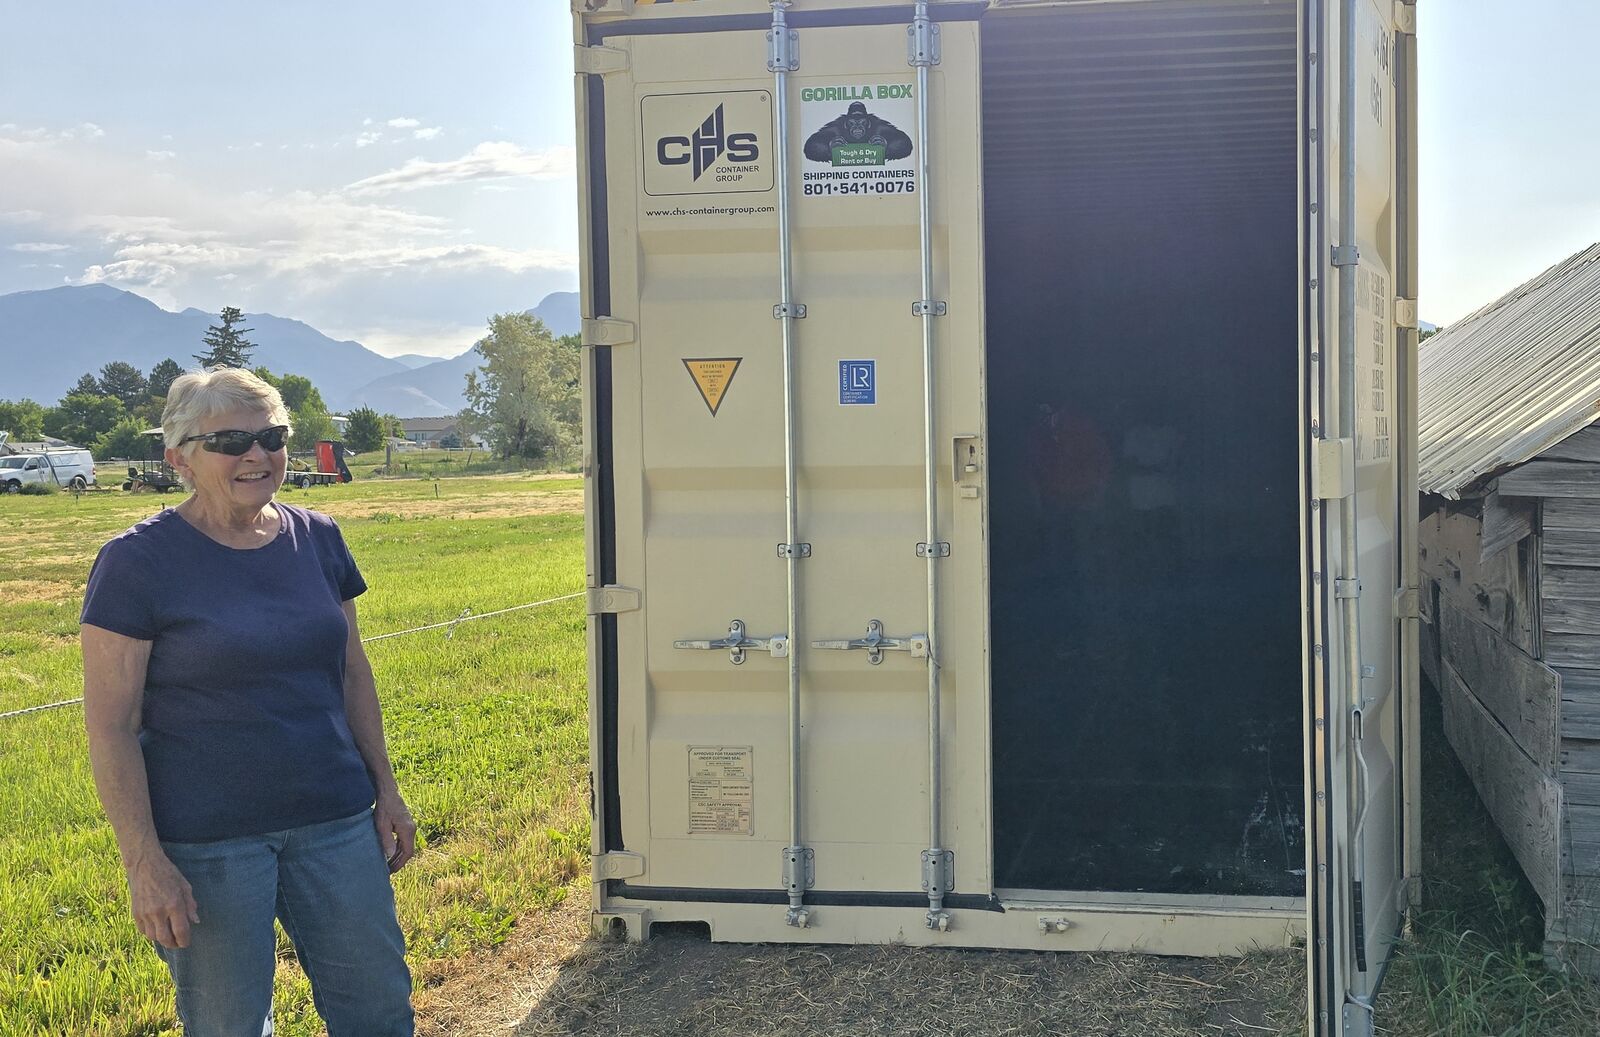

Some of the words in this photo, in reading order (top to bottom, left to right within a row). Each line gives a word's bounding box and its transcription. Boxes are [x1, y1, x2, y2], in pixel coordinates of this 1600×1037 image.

[801, 85, 873, 102] GORILLA
[877, 84, 913, 99] BOX
[657, 102, 759, 182] CHS
[839, 149, 858, 157] Tough
[865, 148, 877, 156] Dry
[715, 165, 760, 174] CONTAINER
[803, 171, 850, 181] SHIPPING
[851, 169, 915, 180] CONTAINERS
[715, 174, 743, 182] GROUP
[646, 205, 775, 217] www.chs-containergroup.com
[853, 367, 870, 388] LR
